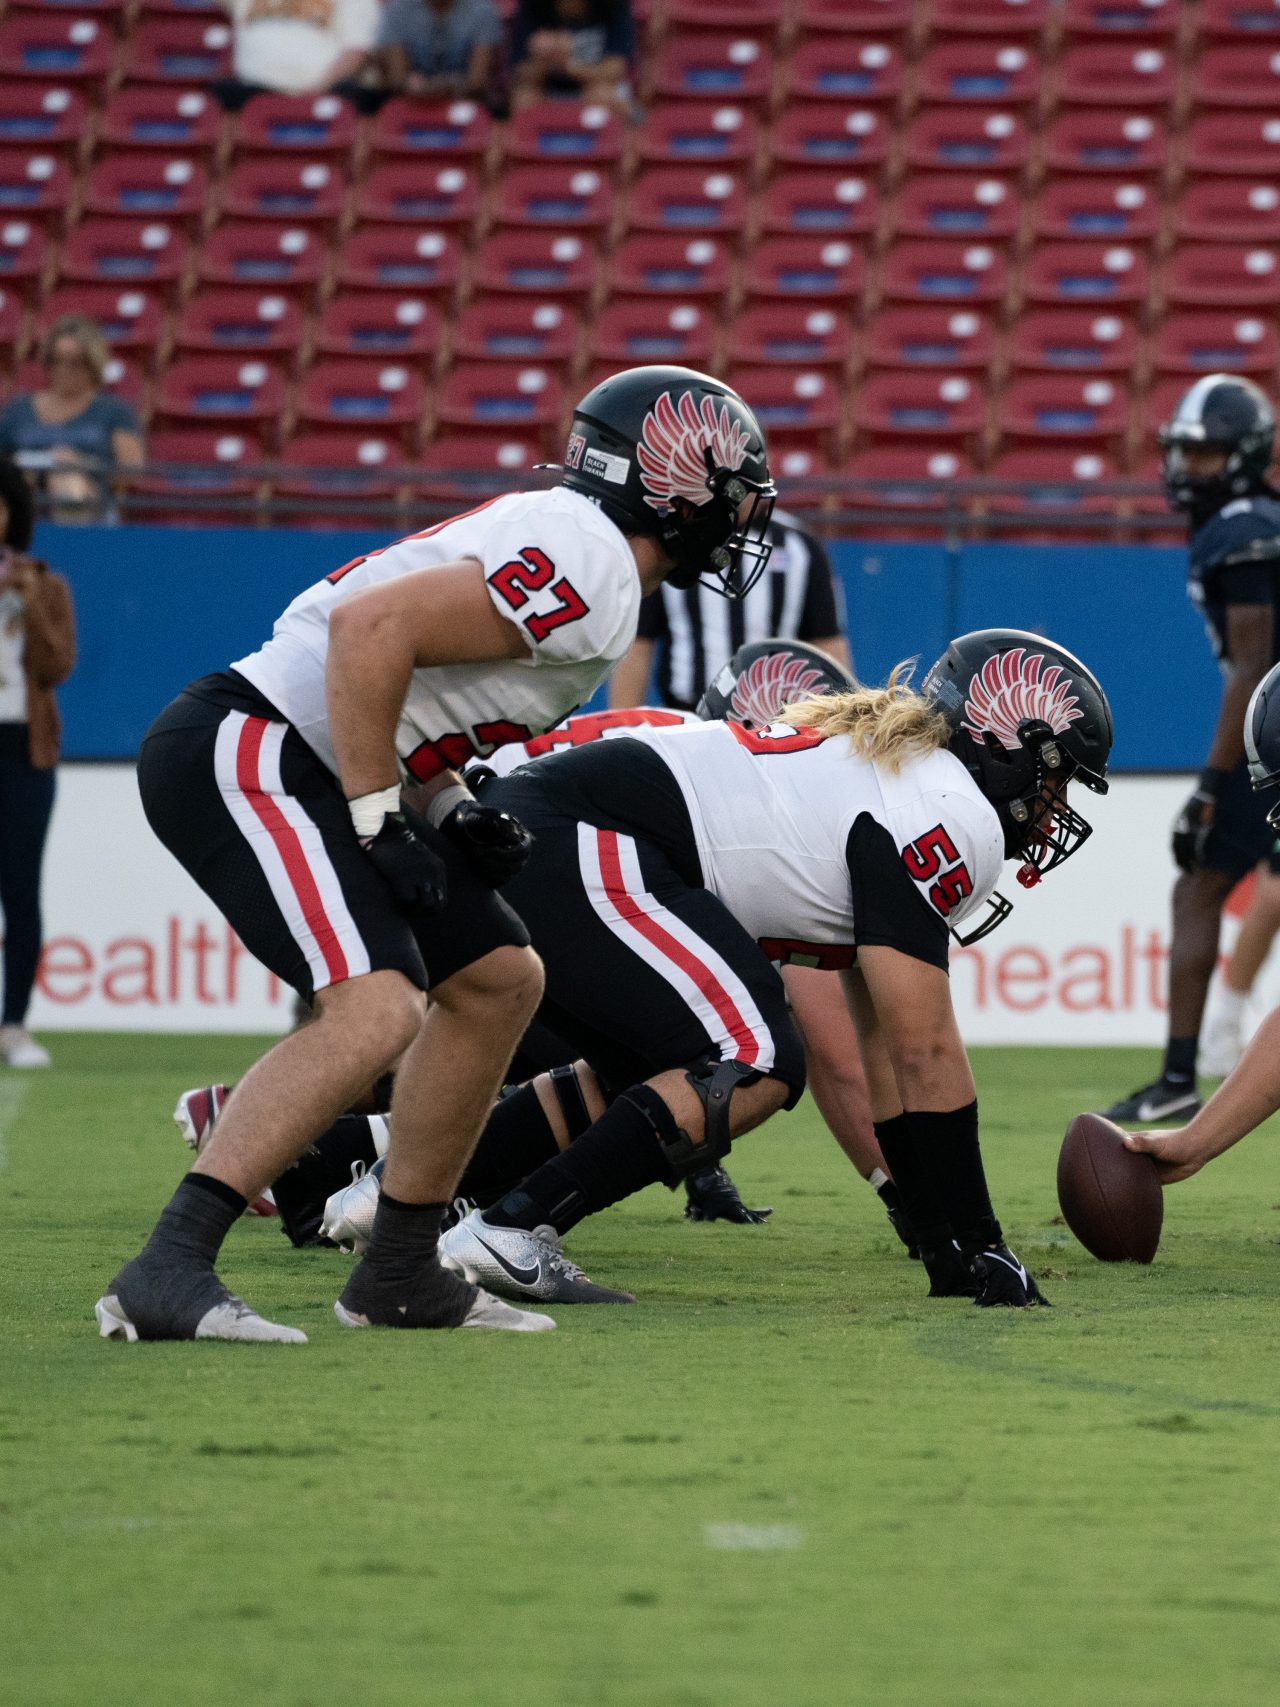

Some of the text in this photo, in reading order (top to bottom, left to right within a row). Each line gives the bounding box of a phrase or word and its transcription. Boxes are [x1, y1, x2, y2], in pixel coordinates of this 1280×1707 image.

[486, 546, 591, 645] 27
[901, 823, 974, 918] 55
[36, 914, 281, 1005] ealth
